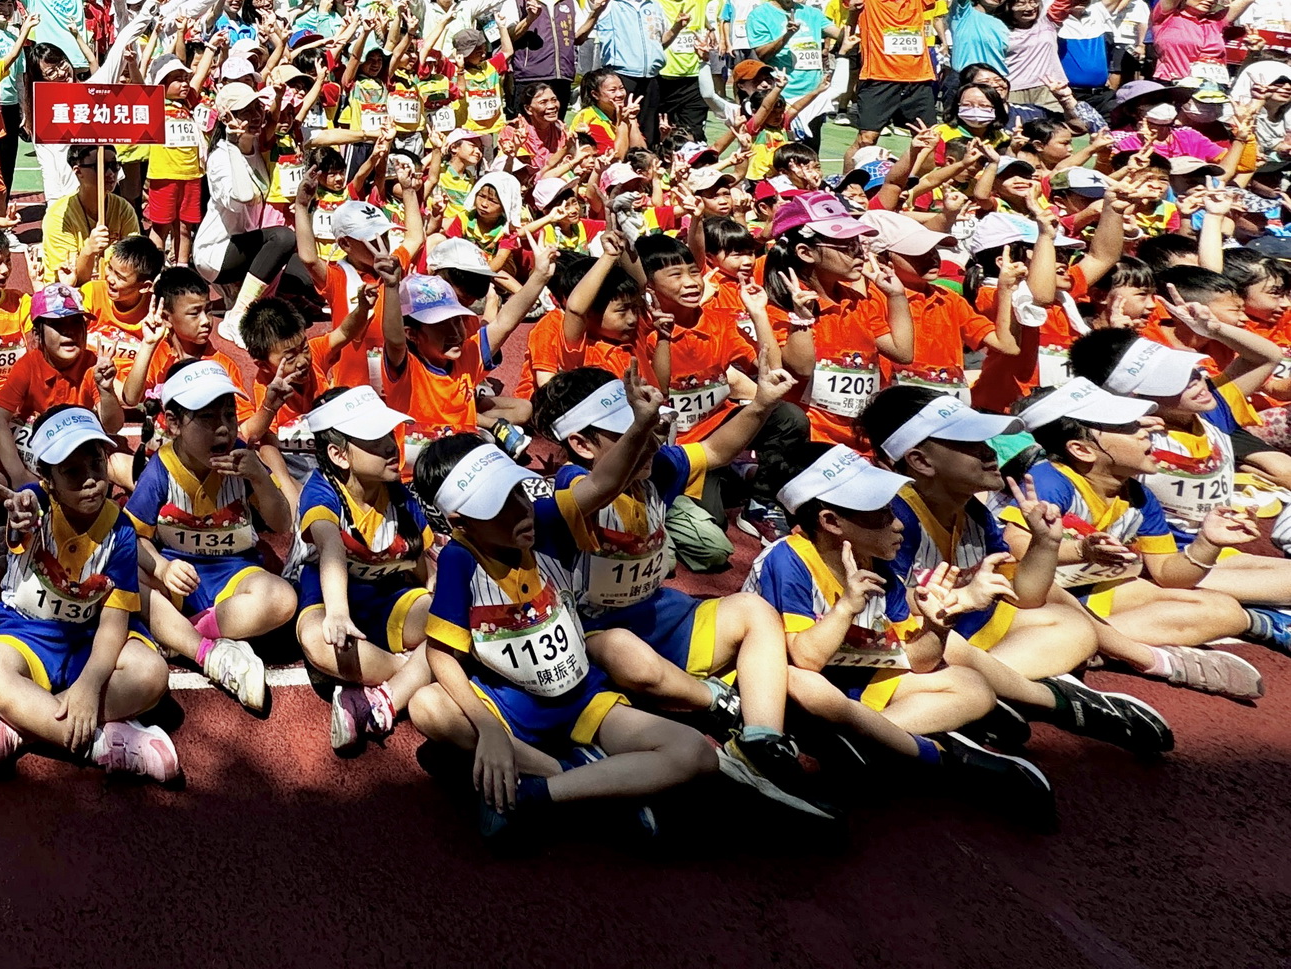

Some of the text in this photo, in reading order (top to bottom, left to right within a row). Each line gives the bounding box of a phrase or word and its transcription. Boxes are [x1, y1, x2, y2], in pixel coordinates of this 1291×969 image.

[892, 37, 917, 45] 2269
[52, 103, 150, 125] 重愛幼兒園
[171, 123, 194, 133] 1162
[828, 375, 874, 395] 1203
[1171, 474, 1229, 500] 1126
[175, 532, 236, 547] 1134
[612, 552, 663, 583] 1142
[501, 624, 569, 669] 1139
[536, 653, 577, 687] 陳振宇
